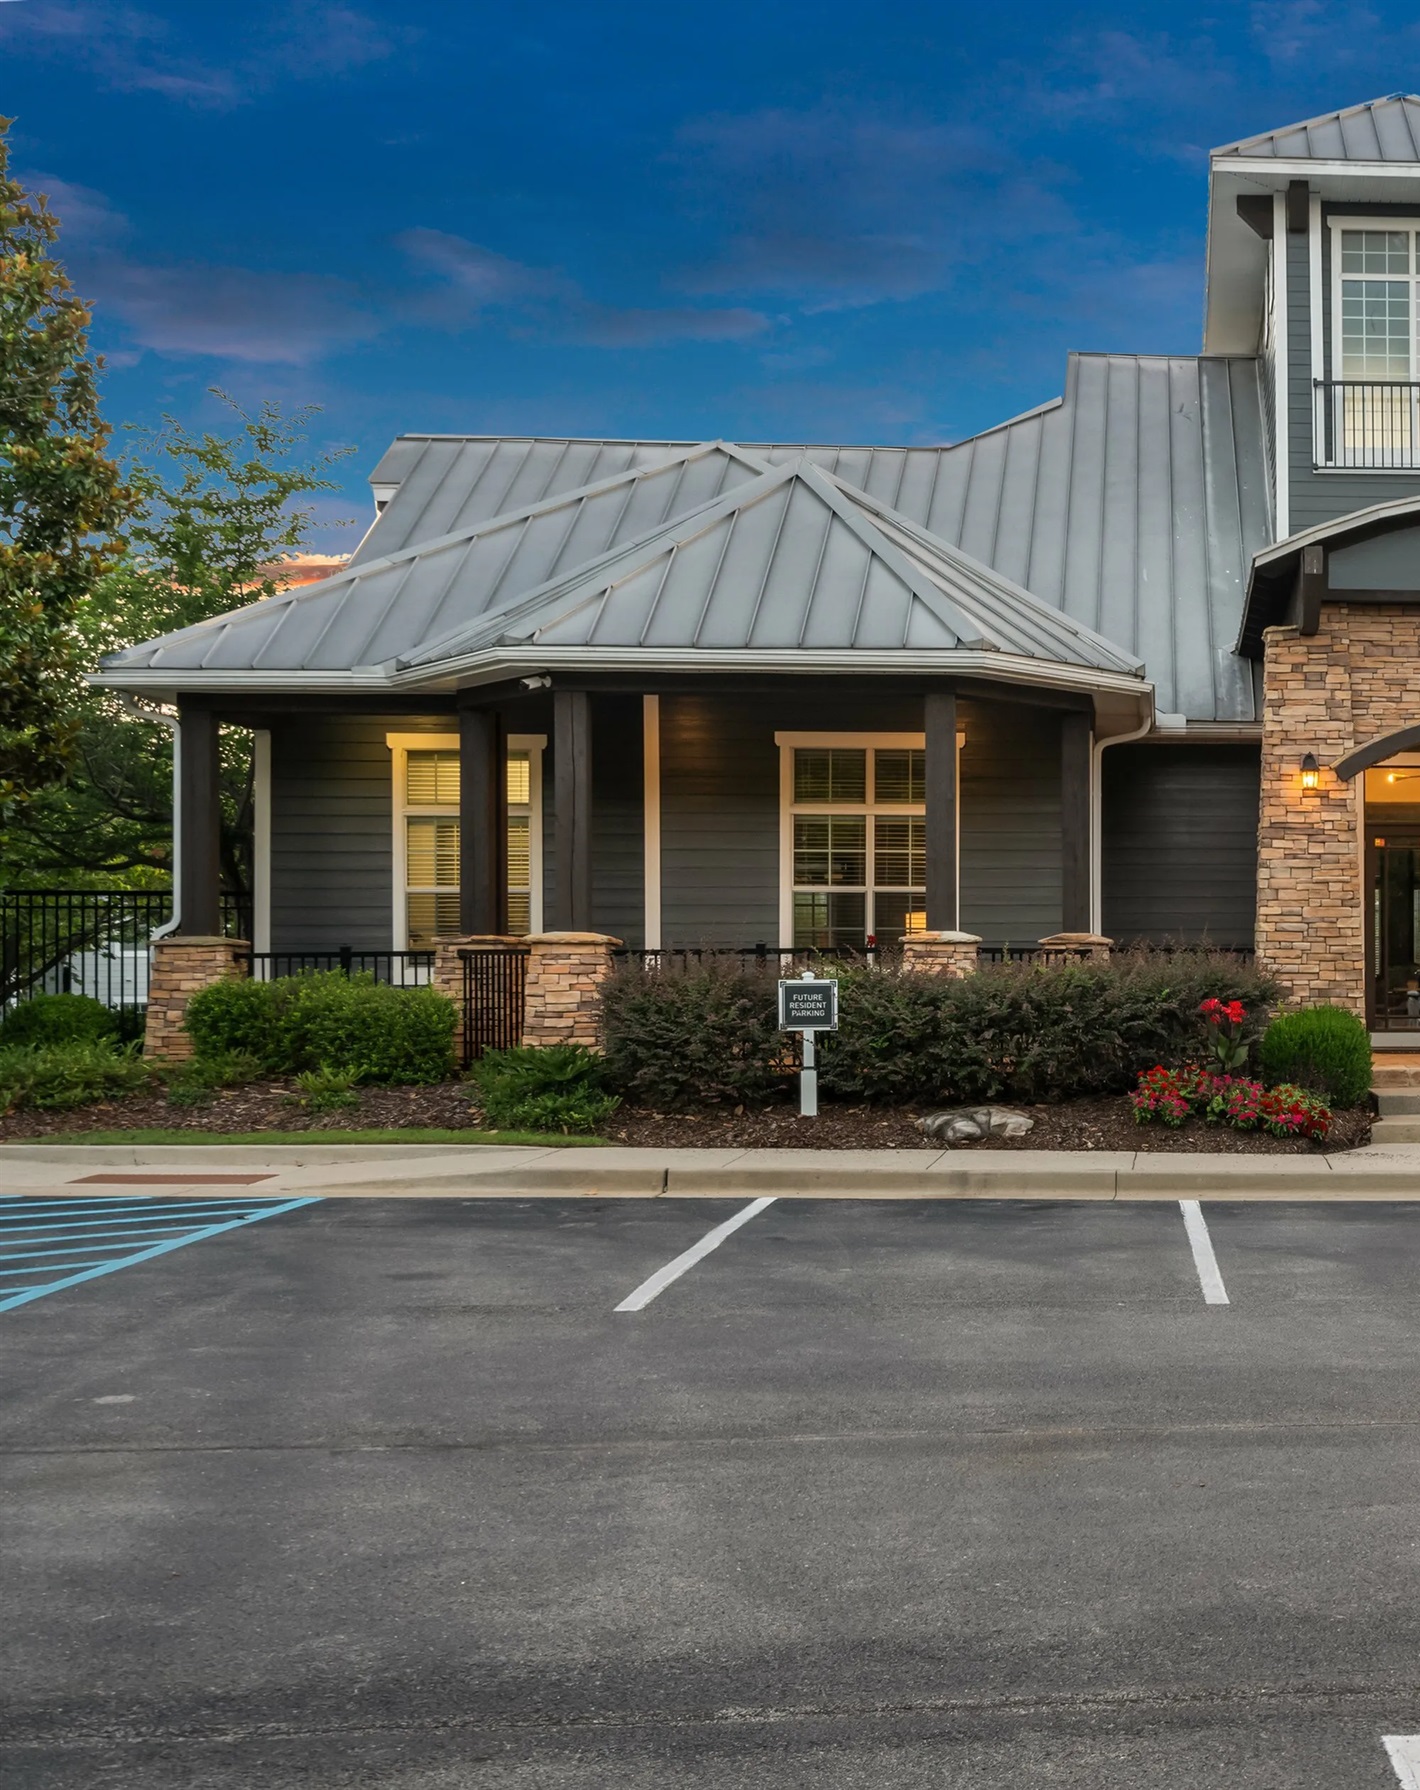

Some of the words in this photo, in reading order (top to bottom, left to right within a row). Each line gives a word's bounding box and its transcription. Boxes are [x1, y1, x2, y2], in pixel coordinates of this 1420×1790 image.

[792, 993, 824, 1001] FUTURE
[789, 1001, 827, 1009] RESIDENT
[791, 1009, 826, 1017] PARKING
